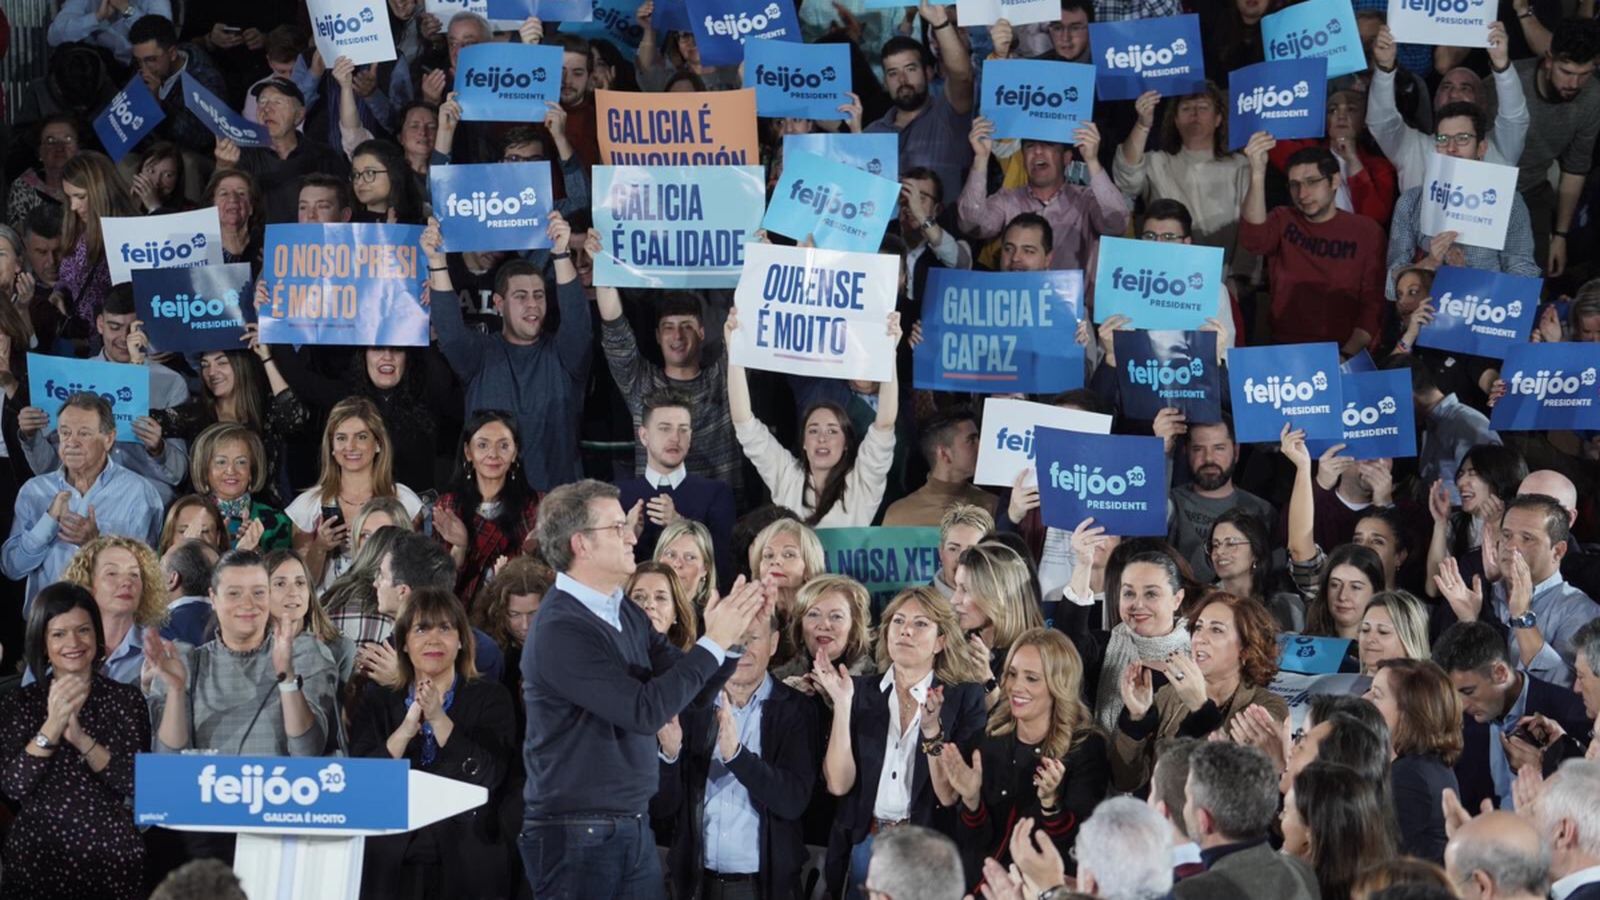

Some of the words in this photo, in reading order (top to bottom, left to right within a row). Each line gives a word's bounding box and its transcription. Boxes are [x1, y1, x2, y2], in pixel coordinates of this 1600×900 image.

[316, 13, 361, 41] feijóo
[705, 12, 768, 41] feijóo
[1435, 16, 1483, 26] PRESIDENTE
[336, 33, 379, 46] PRESIDENTE
[1269, 28, 1329, 59] feijóo
[1105, 43, 1173, 73] feijóo
[1142, 65, 1190, 78] PRESIDENTE
[465, 66, 531, 93] feijóo
[755, 64, 821, 92] feijóo
[498, 91, 545, 100] PRESIDENTE
[790, 91, 837, 99] PRESIDENTE
[995, 84, 1062, 111] feijóo
[1237, 85, 1294, 115] feijóo
[608, 107, 695, 144] GALICIA
[698, 103, 714, 144] É
[1029, 110, 1077, 121] PRESIDENTE
[1261, 108, 1309, 119] PRESIDENTE
[446, 191, 520, 223] feijóo
[611, 183, 703, 222] GALICIA
[790, 178, 858, 220] feijóo
[1430, 180, 1480, 211] feijóo
[487, 218, 538, 229] PRESIDENTE
[121, 240, 192, 268] feijóo
[612, 223, 627, 265] É
[631, 229, 745, 267] CALIDADE
[274, 244, 288, 278] O
[291, 244, 350, 278] NOSO
[354, 245, 417, 279] PRESI
[763, 263, 866, 310] OURENSE
[1112, 267, 1186, 299] feijóo
[150, 293, 225, 324] feijóo
[272, 278, 285, 318] É
[288, 284, 357, 319] MOITO
[943, 286, 1034, 327] GALICIA
[1038, 282, 1053, 327] É
[1150, 298, 1202, 311] PRESIDENTE
[1438, 292, 1506, 325] feijóo
[191, 318, 246, 330] PRESIDENTE
[756, 303, 770, 348] É
[774, 311, 848, 355] MOITO
[1471, 325, 1517, 339] PRESIDENTE
[942, 331, 1018, 372] CAPAZ
[1128, 358, 1191, 392] feijóo
[1511, 370, 1580, 401] feijóo
[1159, 388, 1205, 399] PRESIDENTE
[1243, 375, 1314, 409] feijóo
[1543, 398, 1593, 407] PRESIDENTE
[1282, 404, 1331, 416] PRESIDENTE
[1343, 427, 1399, 440] PRESIDENTE
[1049, 461, 1127, 501] feijóo
[1087, 499, 1148, 511] PRESIDENTE
[838, 547, 900, 583] NOSA
[197, 764, 319, 815] feijóo
[324, 773, 342, 784] 20
[263, 813, 303, 823] GALICIA
[313, 814, 346, 824] MOITO
